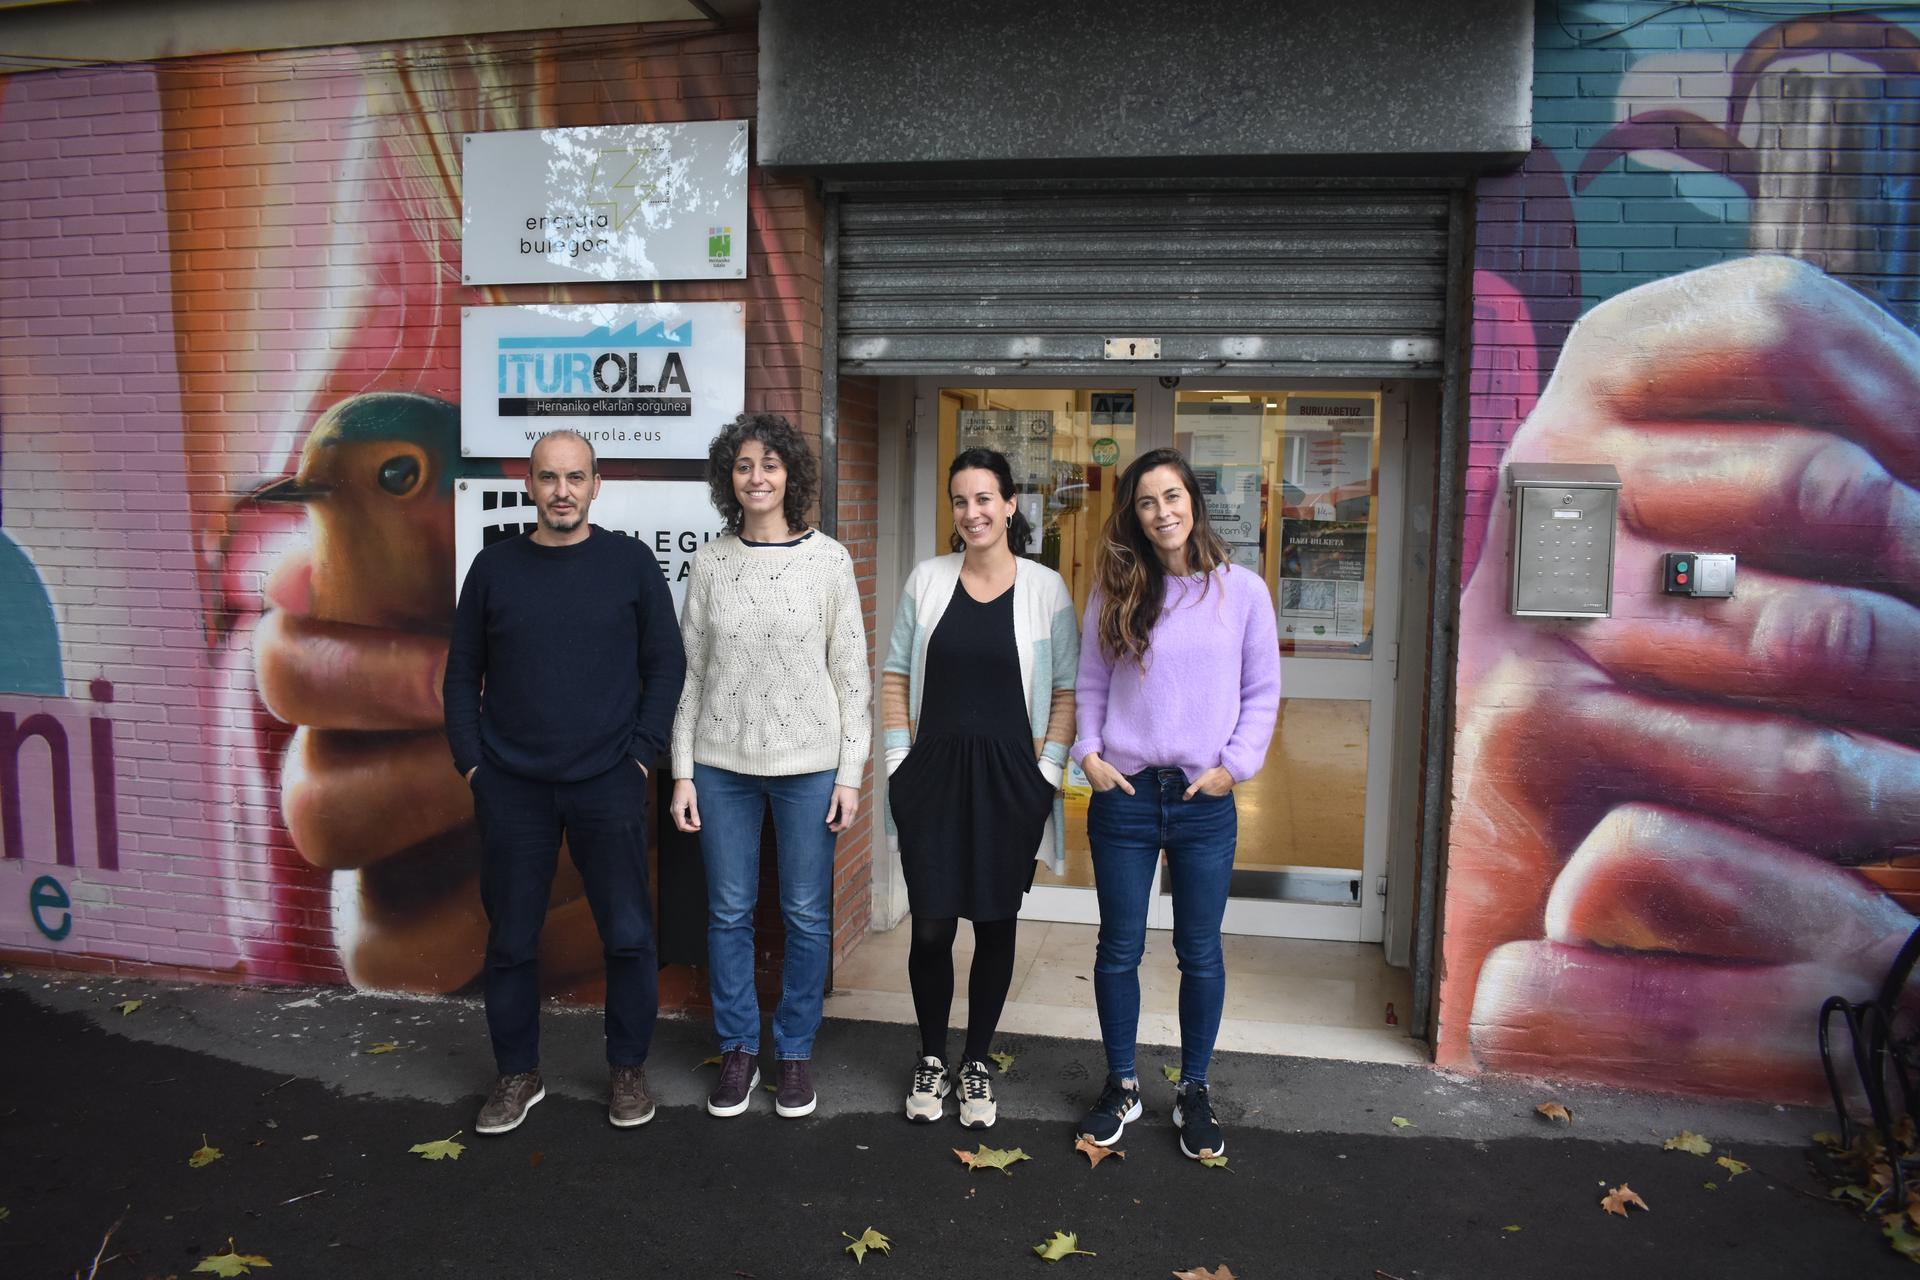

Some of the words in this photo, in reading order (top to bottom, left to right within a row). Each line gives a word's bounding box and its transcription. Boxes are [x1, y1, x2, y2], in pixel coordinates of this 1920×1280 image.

[498, 352, 691, 394] ITUROLA
[537, 401, 590, 412] Hernaniko
[592, 401, 634, 412] elkarlan
[637, 402, 687, 413] sorgunea
[1299, 405, 1361, 417] BURUJABETUZ
